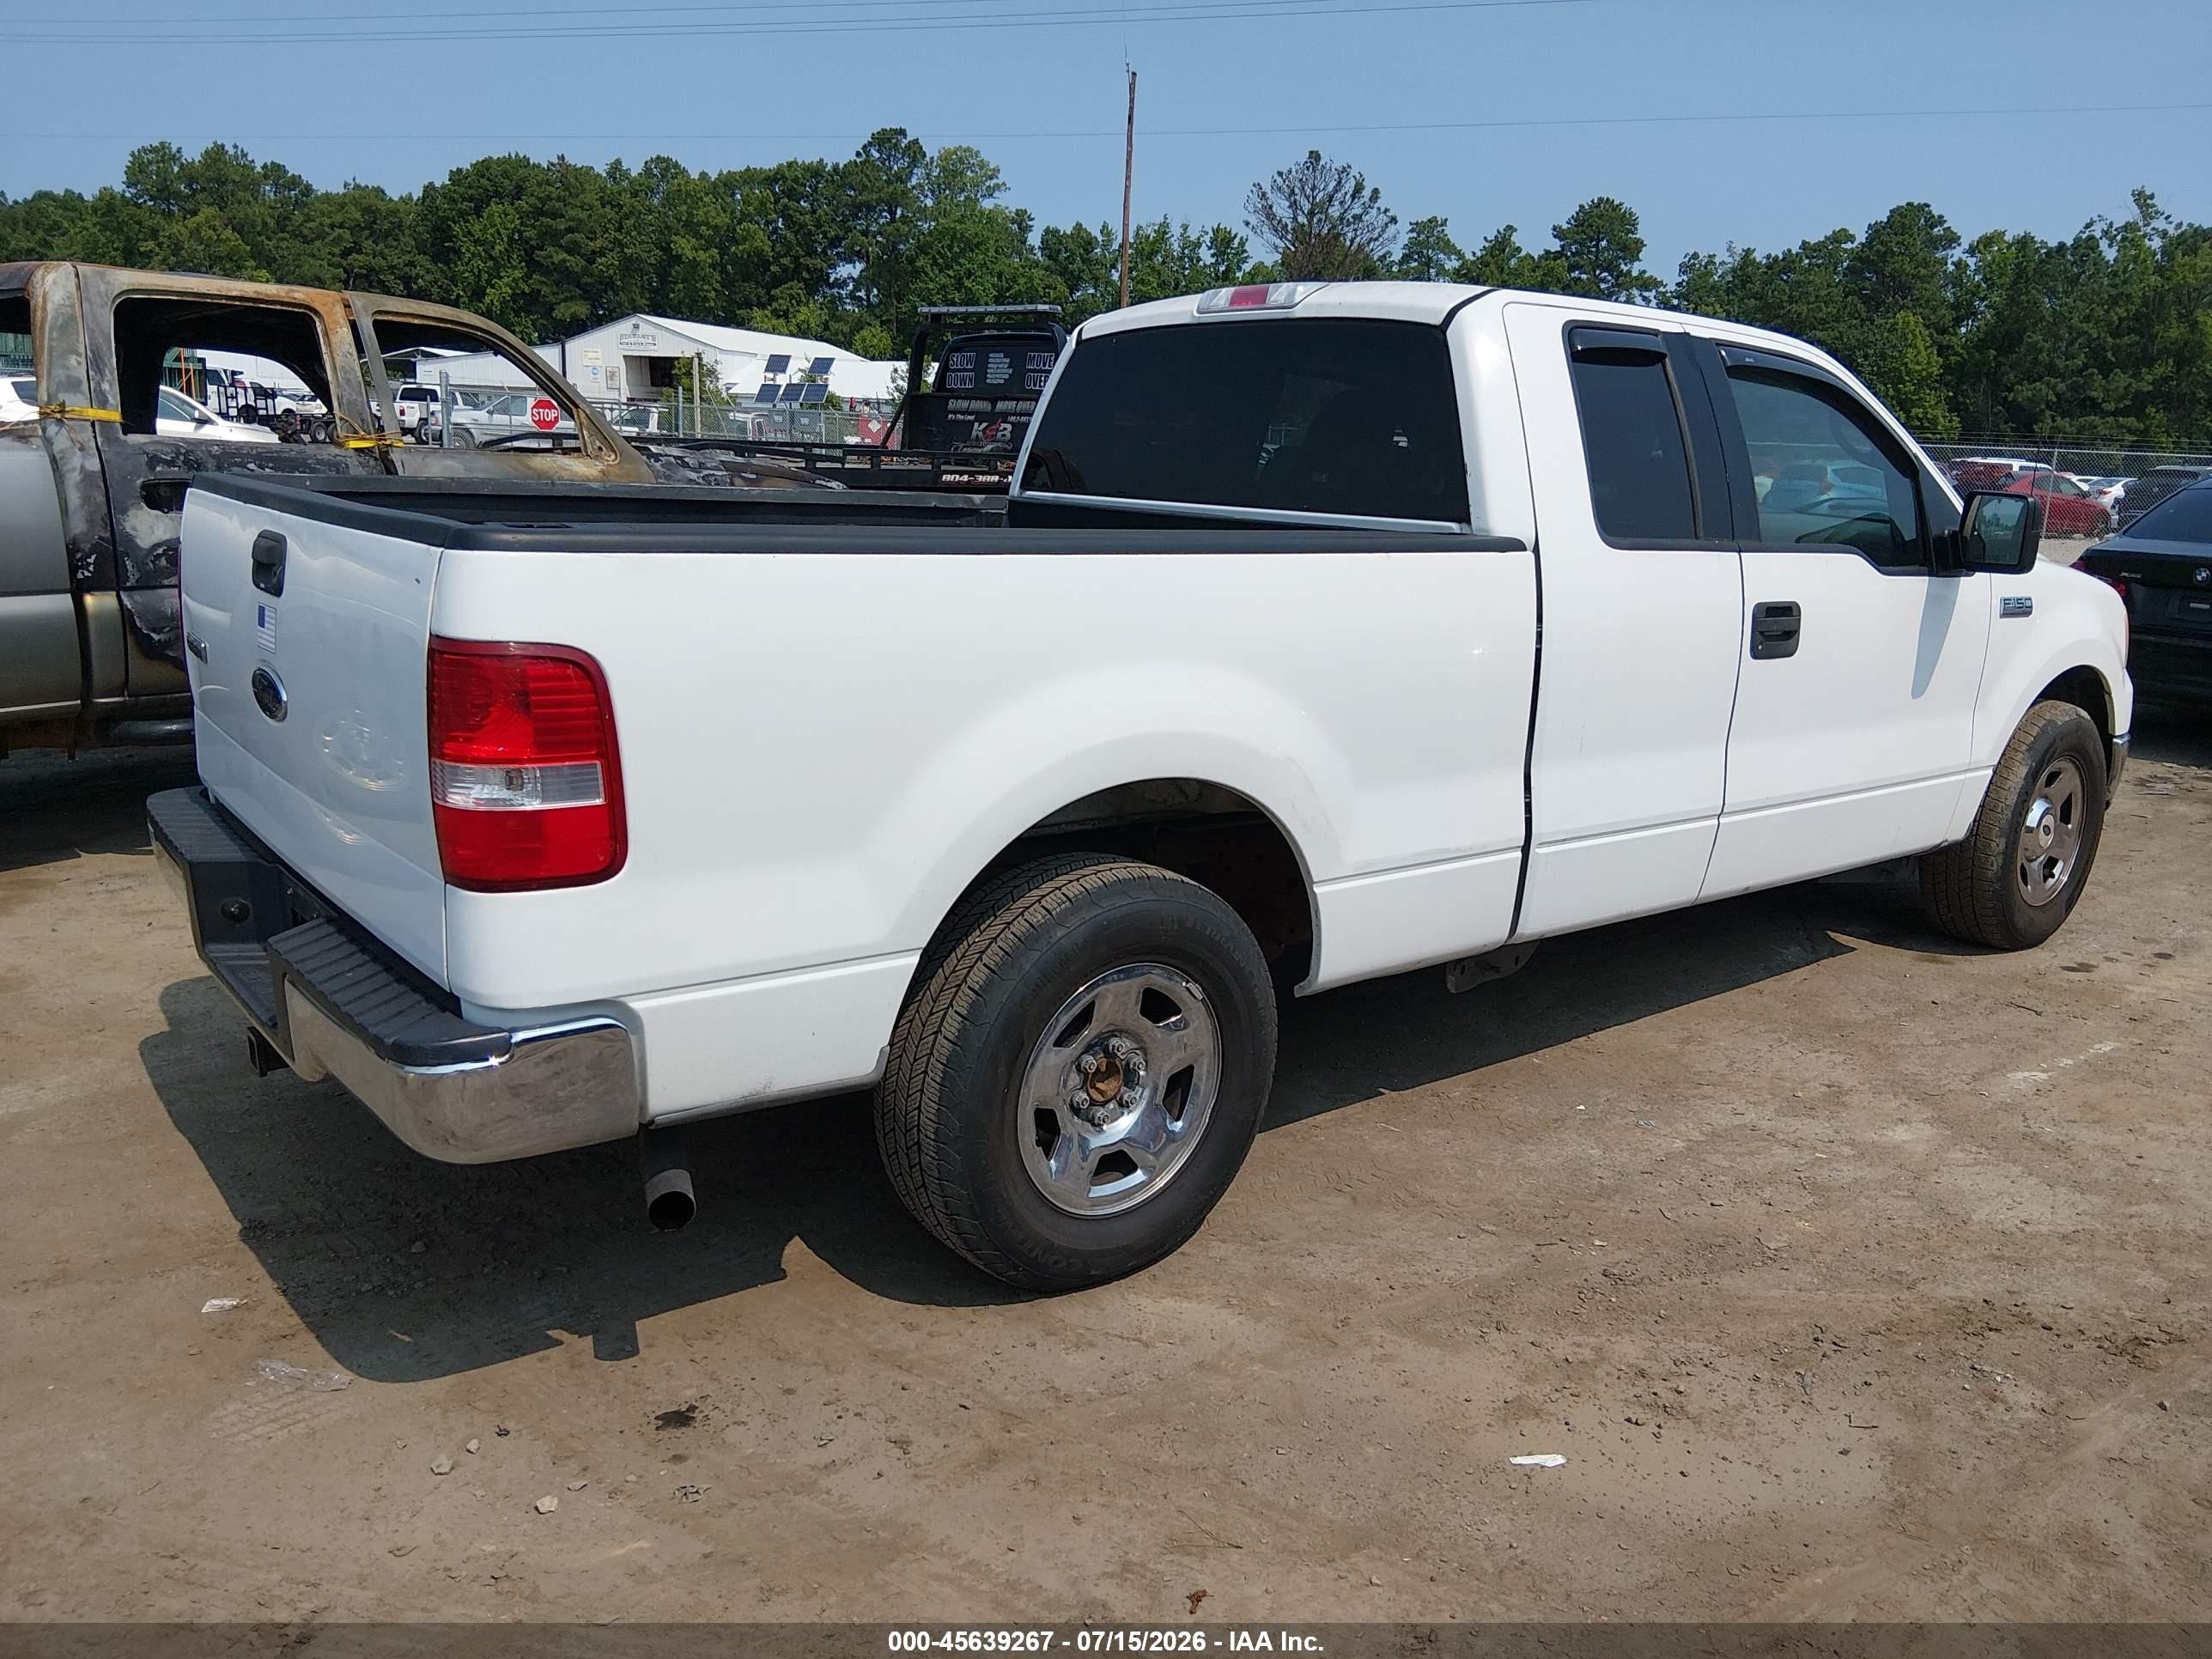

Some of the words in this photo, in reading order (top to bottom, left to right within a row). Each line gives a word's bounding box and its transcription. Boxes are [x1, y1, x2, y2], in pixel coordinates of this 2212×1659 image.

[949, 353, 976, 368] SLOW
[1025, 352, 1055, 369] MOVE
[946, 372, 975, 388] DOWN
[947, 398, 969, 411] SLOW
[994, 400, 1017, 413] MOVE
[532, 408, 558, 422] STOP
